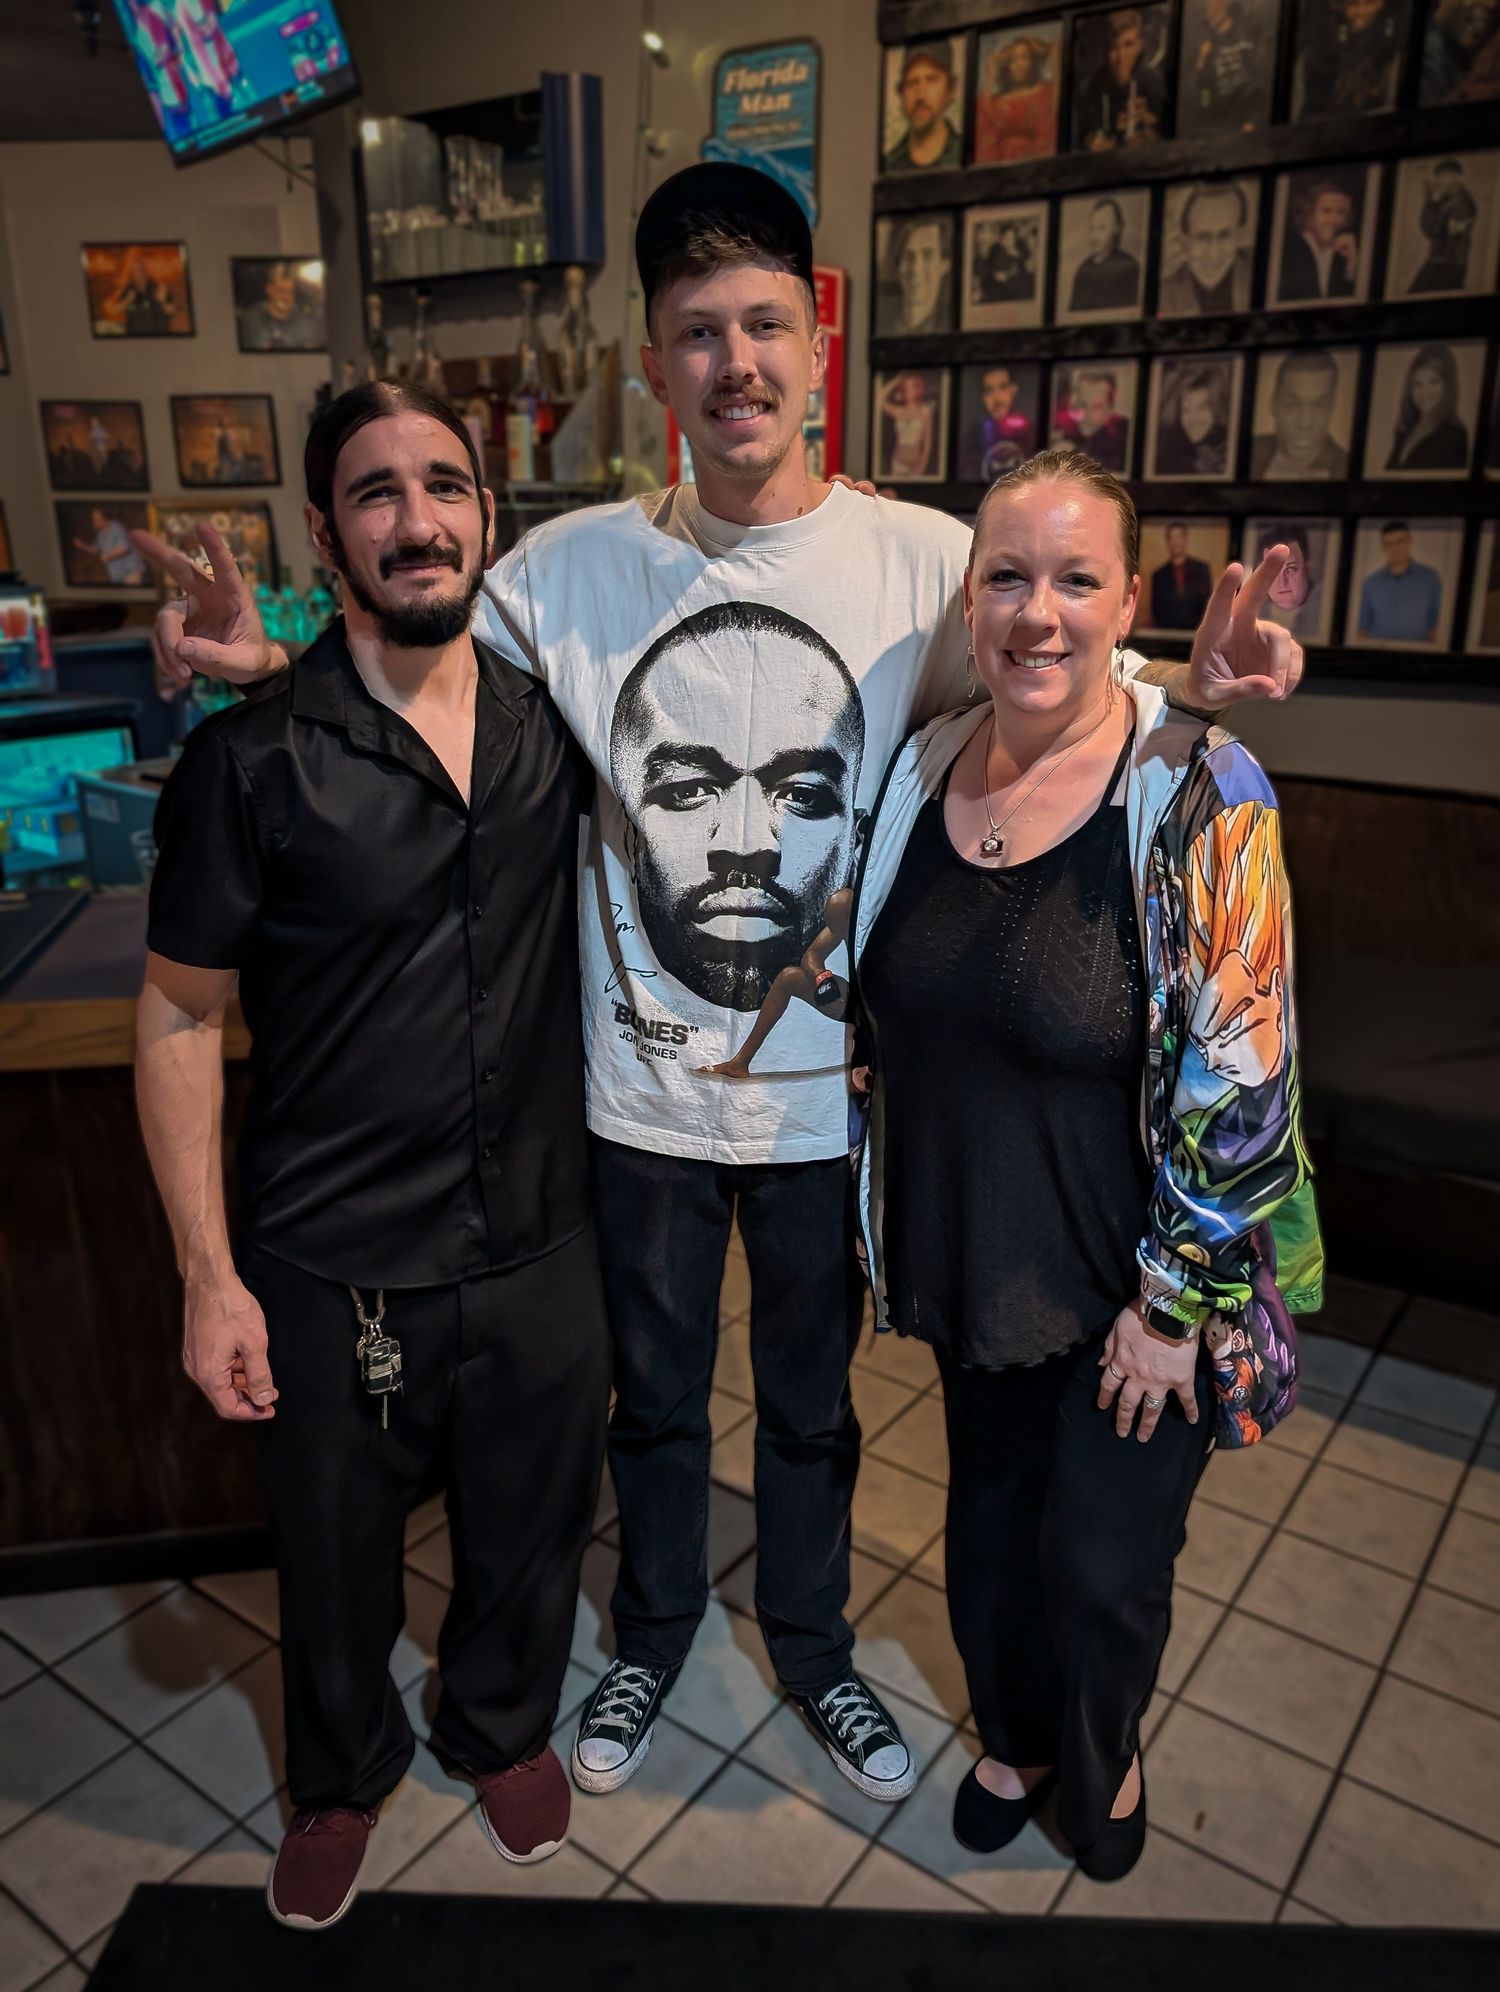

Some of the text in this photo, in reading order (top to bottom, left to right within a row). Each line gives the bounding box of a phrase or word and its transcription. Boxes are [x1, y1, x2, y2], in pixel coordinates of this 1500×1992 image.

[723, 59, 809, 94] Florida
[739, 92, 791, 114] Man
[640, 1043, 678, 1060] JONES
